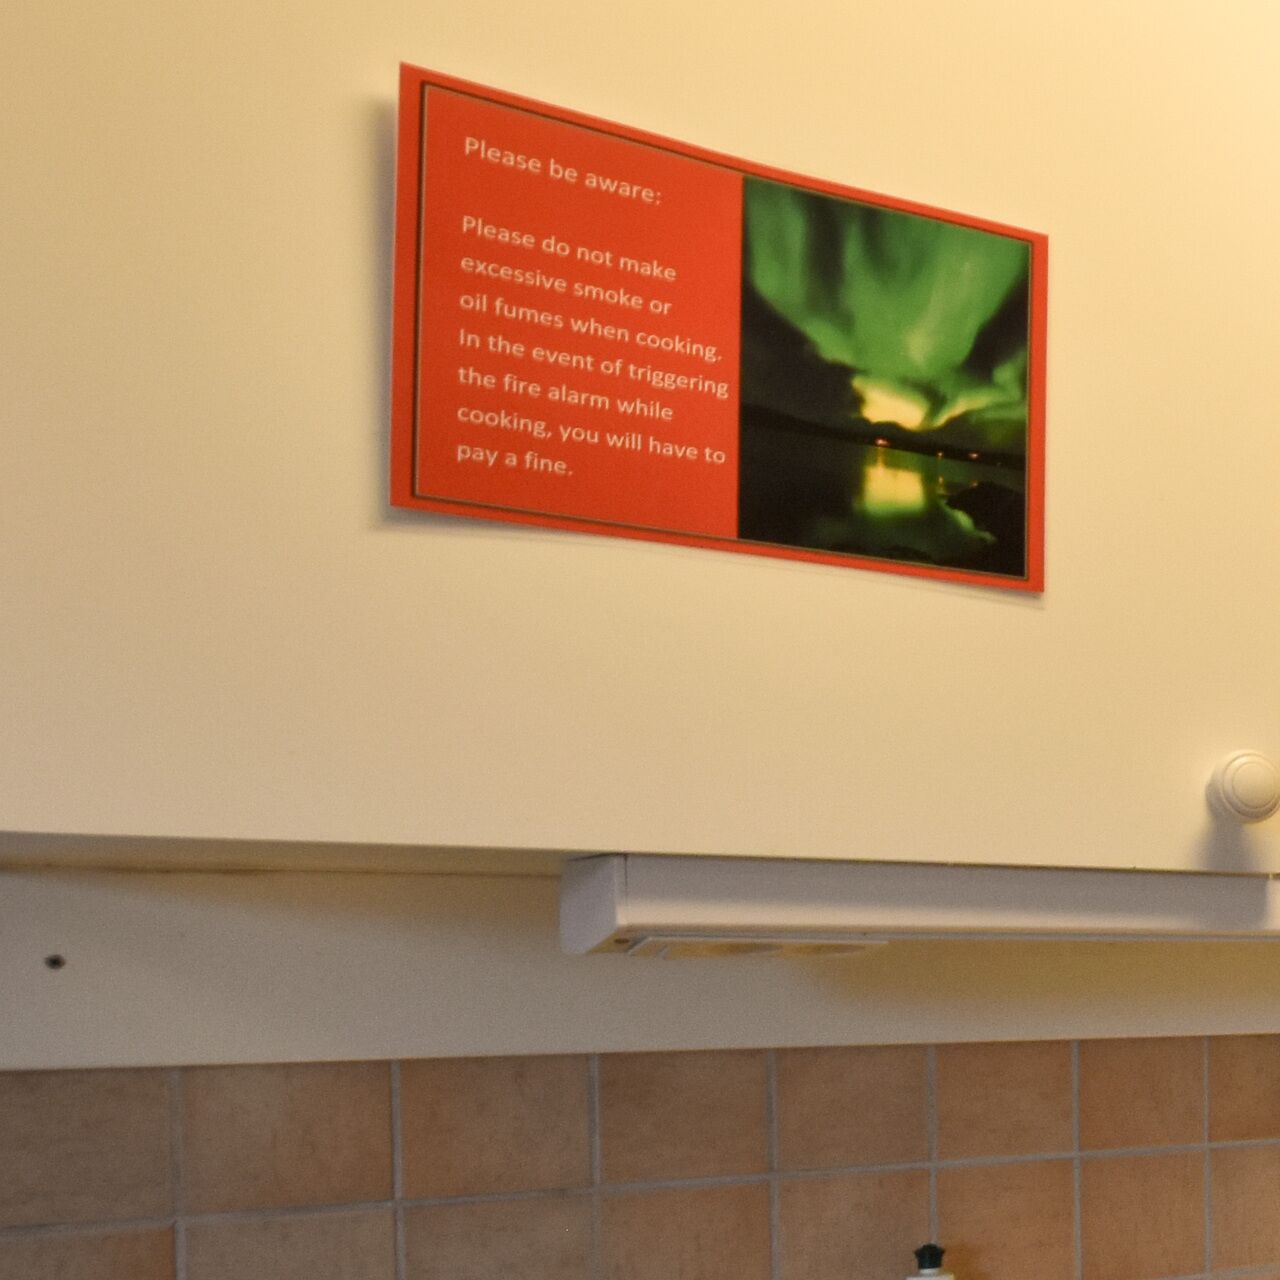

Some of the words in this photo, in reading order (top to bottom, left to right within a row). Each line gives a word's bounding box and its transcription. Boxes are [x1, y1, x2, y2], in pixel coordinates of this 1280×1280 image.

[464, 136, 542, 173] Please
[550, 158, 578, 182] be
[584, 172, 662, 205] aware:
[462, 215, 535, 248] Please
[542, 236, 570, 256] do
[576, 246, 613, 267] not
[619, 256, 677, 282] make
[461, 256, 567, 293] excessive
[574, 280, 643, 310] smoke
[649, 300, 672, 315] or
[460, 294, 487, 317] oil
[494, 297, 564, 329] fumes
[570, 317, 629, 343] when
[636, 331, 722, 363] cooking.
[458, 366, 496, 389] the
[503, 374, 542, 396] fire
[548, 383, 610, 410] alarm
[617, 398, 674, 420] while
[459, 328, 480, 348] In
[488, 334, 524, 357] the
[532, 346, 594, 372] event
[600, 359, 623, 376] of
[628, 362, 729, 400] triggering
[457, 406, 552, 440] cooking,
[559, 424, 599, 444] you
[606, 431, 642, 452] will
[648, 436, 698, 460] have
[704, 446, 726, 465] to
[457, 444, 498, 468] pay
[505, 451, 518, 467] a
[524, 450, 574, 476] fine.
